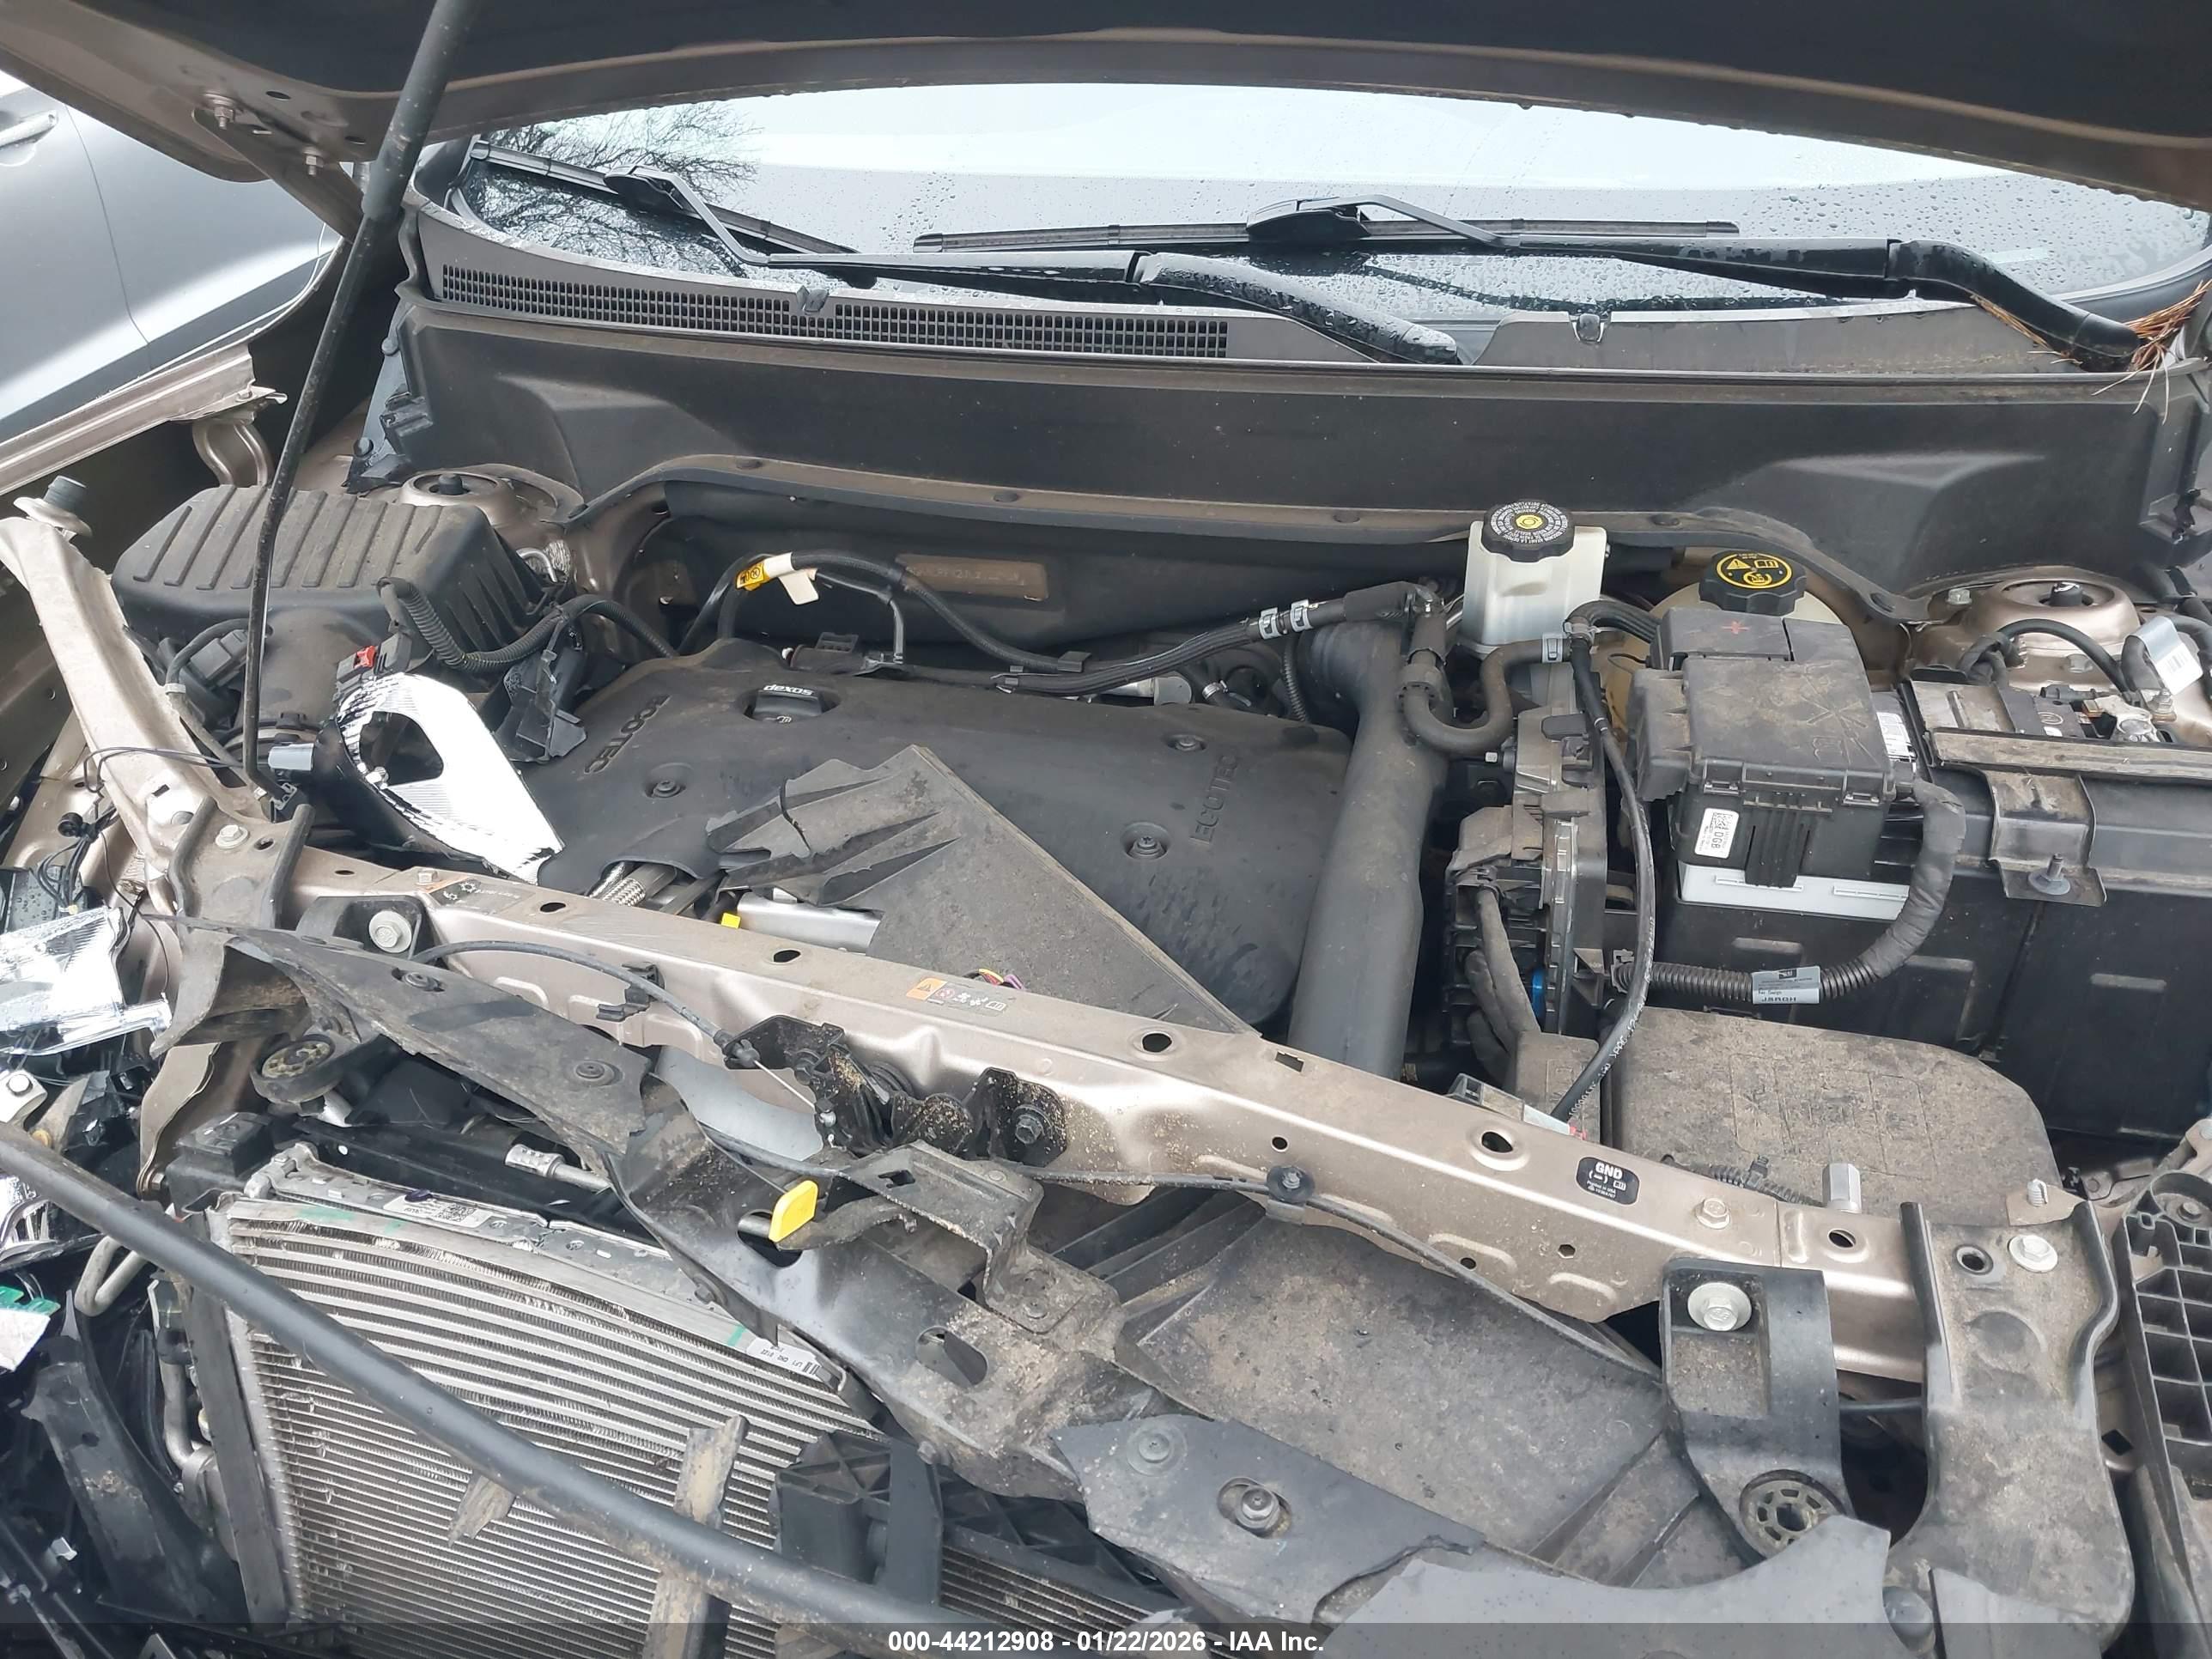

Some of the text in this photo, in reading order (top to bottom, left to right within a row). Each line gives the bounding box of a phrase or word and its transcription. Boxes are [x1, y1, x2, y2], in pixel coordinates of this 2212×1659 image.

[763, 684, 814, 696] dexos
[1189, 754, 1238, 845] ECOTEC
[1595, 1162, 1623, 1180] GND
